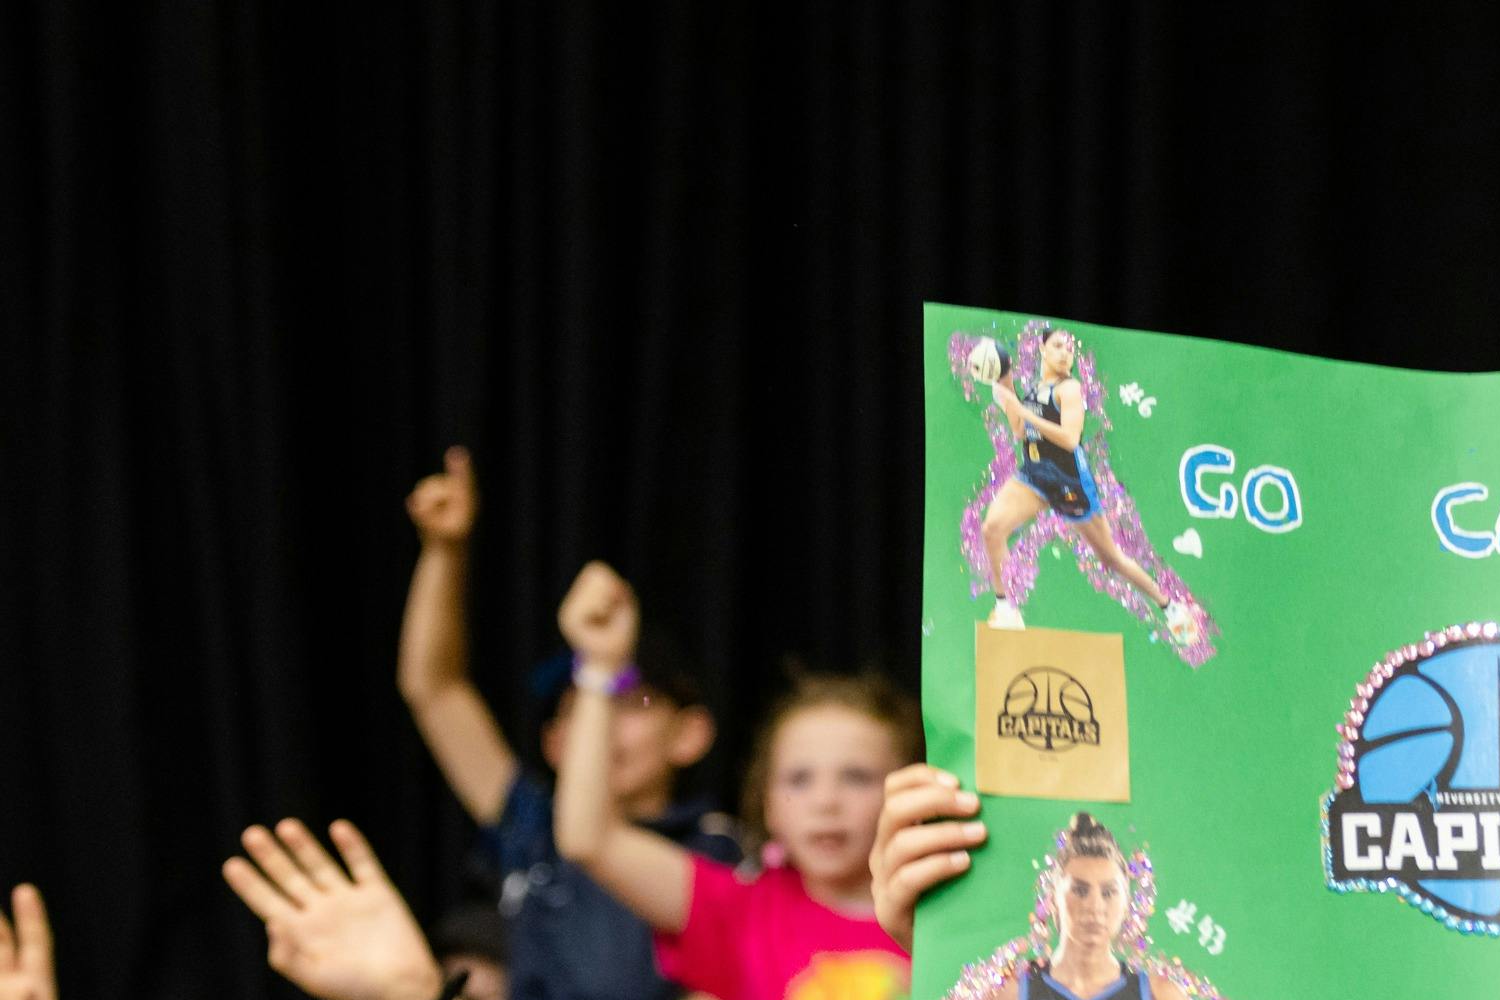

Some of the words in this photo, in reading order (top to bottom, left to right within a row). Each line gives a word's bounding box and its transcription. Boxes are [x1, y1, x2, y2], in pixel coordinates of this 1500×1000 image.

[1119, 382, 1157, 418] #6
[1180, 444, 1302, 533] GO
[1165, 899, 1226, 955] #43
